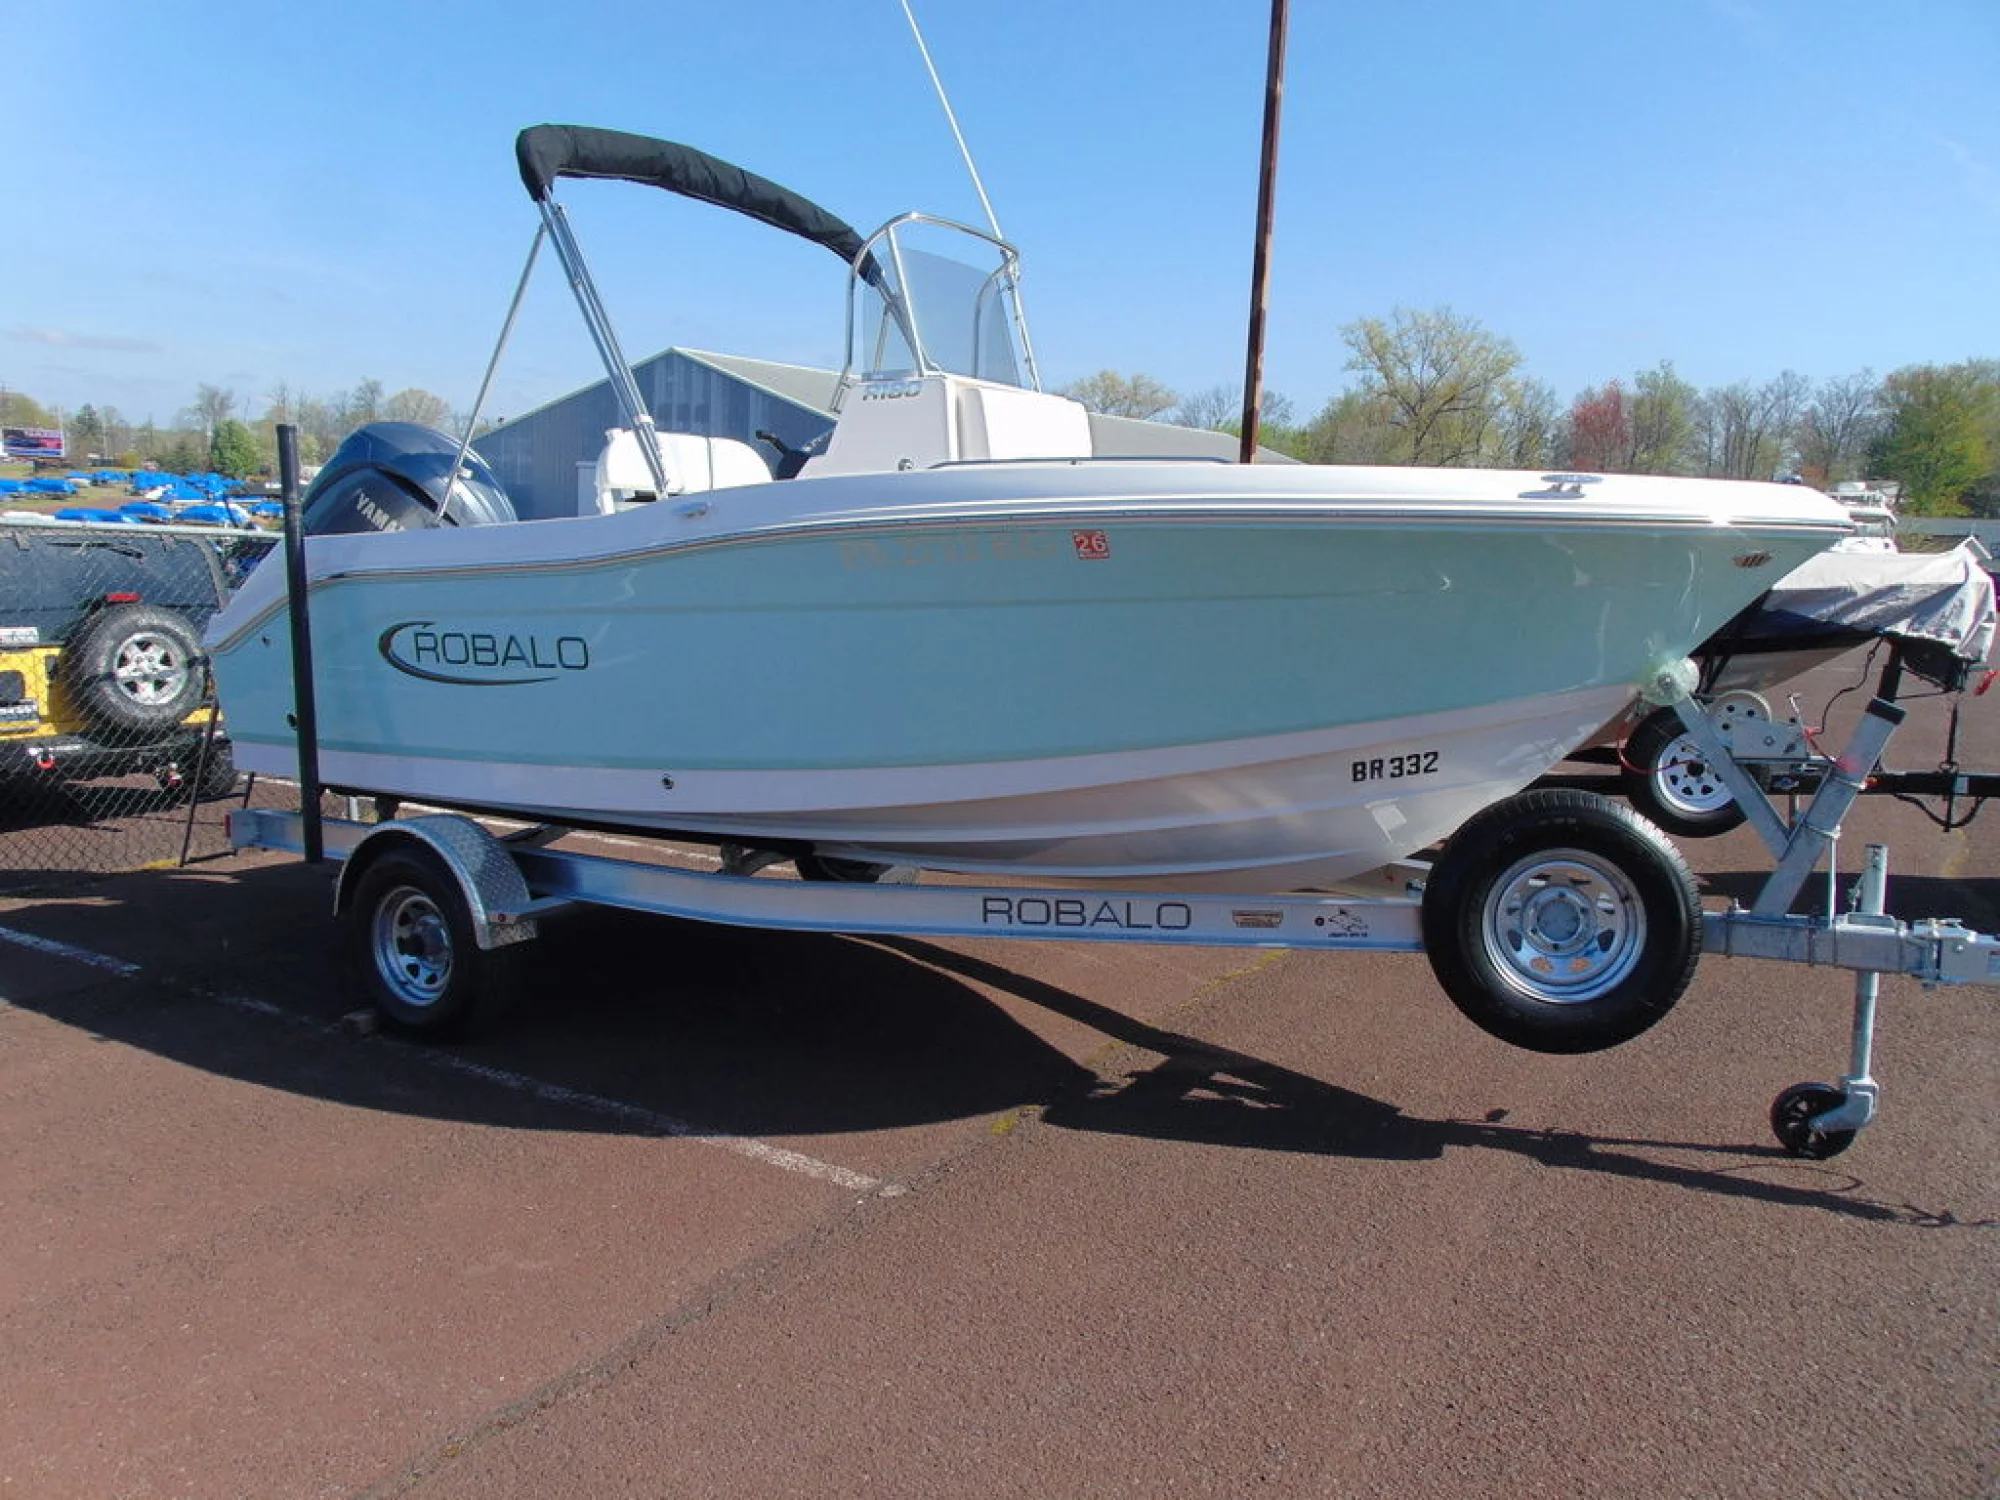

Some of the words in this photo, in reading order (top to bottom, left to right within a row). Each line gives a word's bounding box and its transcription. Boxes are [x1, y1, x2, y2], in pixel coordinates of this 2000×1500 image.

[1075, 533, 1107, 551] 26
[413, 632, 589, 670] ROBALO
[983, 897, 1191, 930] ROBALO
